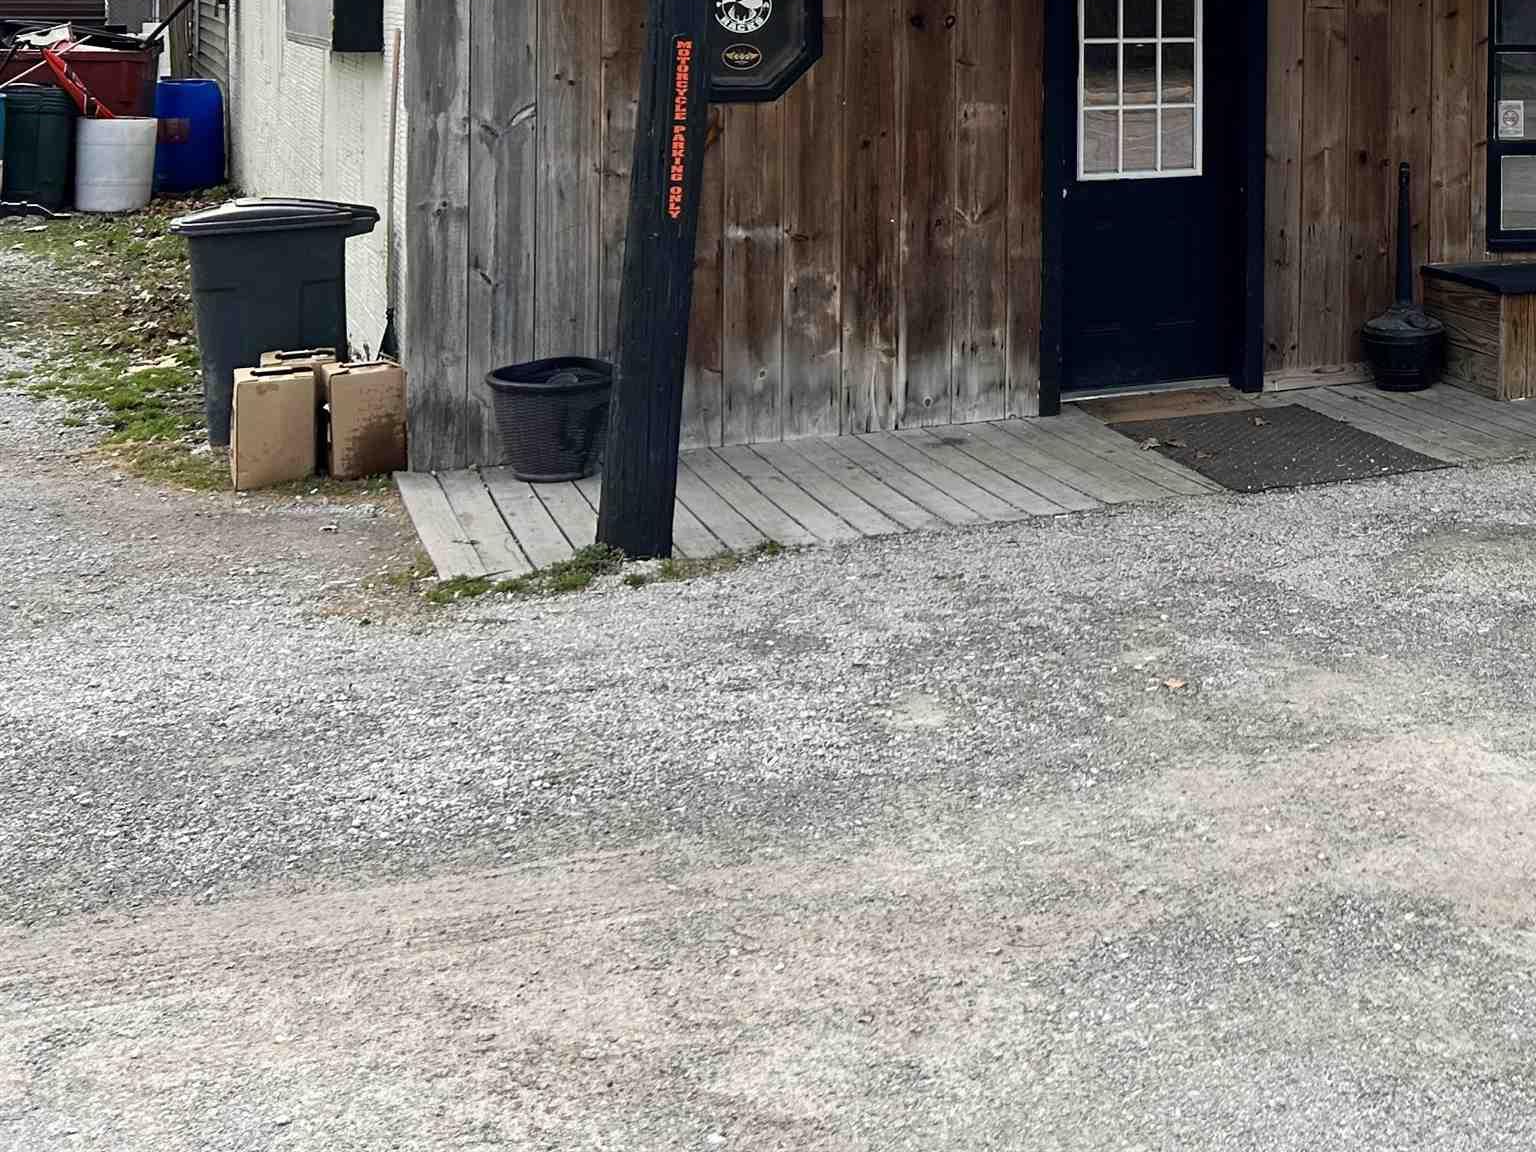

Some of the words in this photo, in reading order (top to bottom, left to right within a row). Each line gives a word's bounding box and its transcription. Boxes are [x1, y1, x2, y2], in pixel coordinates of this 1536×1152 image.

[674, 40, 693, 121] MOTORCYCLE
[670, 125, 687, 182] PARKING
[667, 186, 682, 220] ONLY
